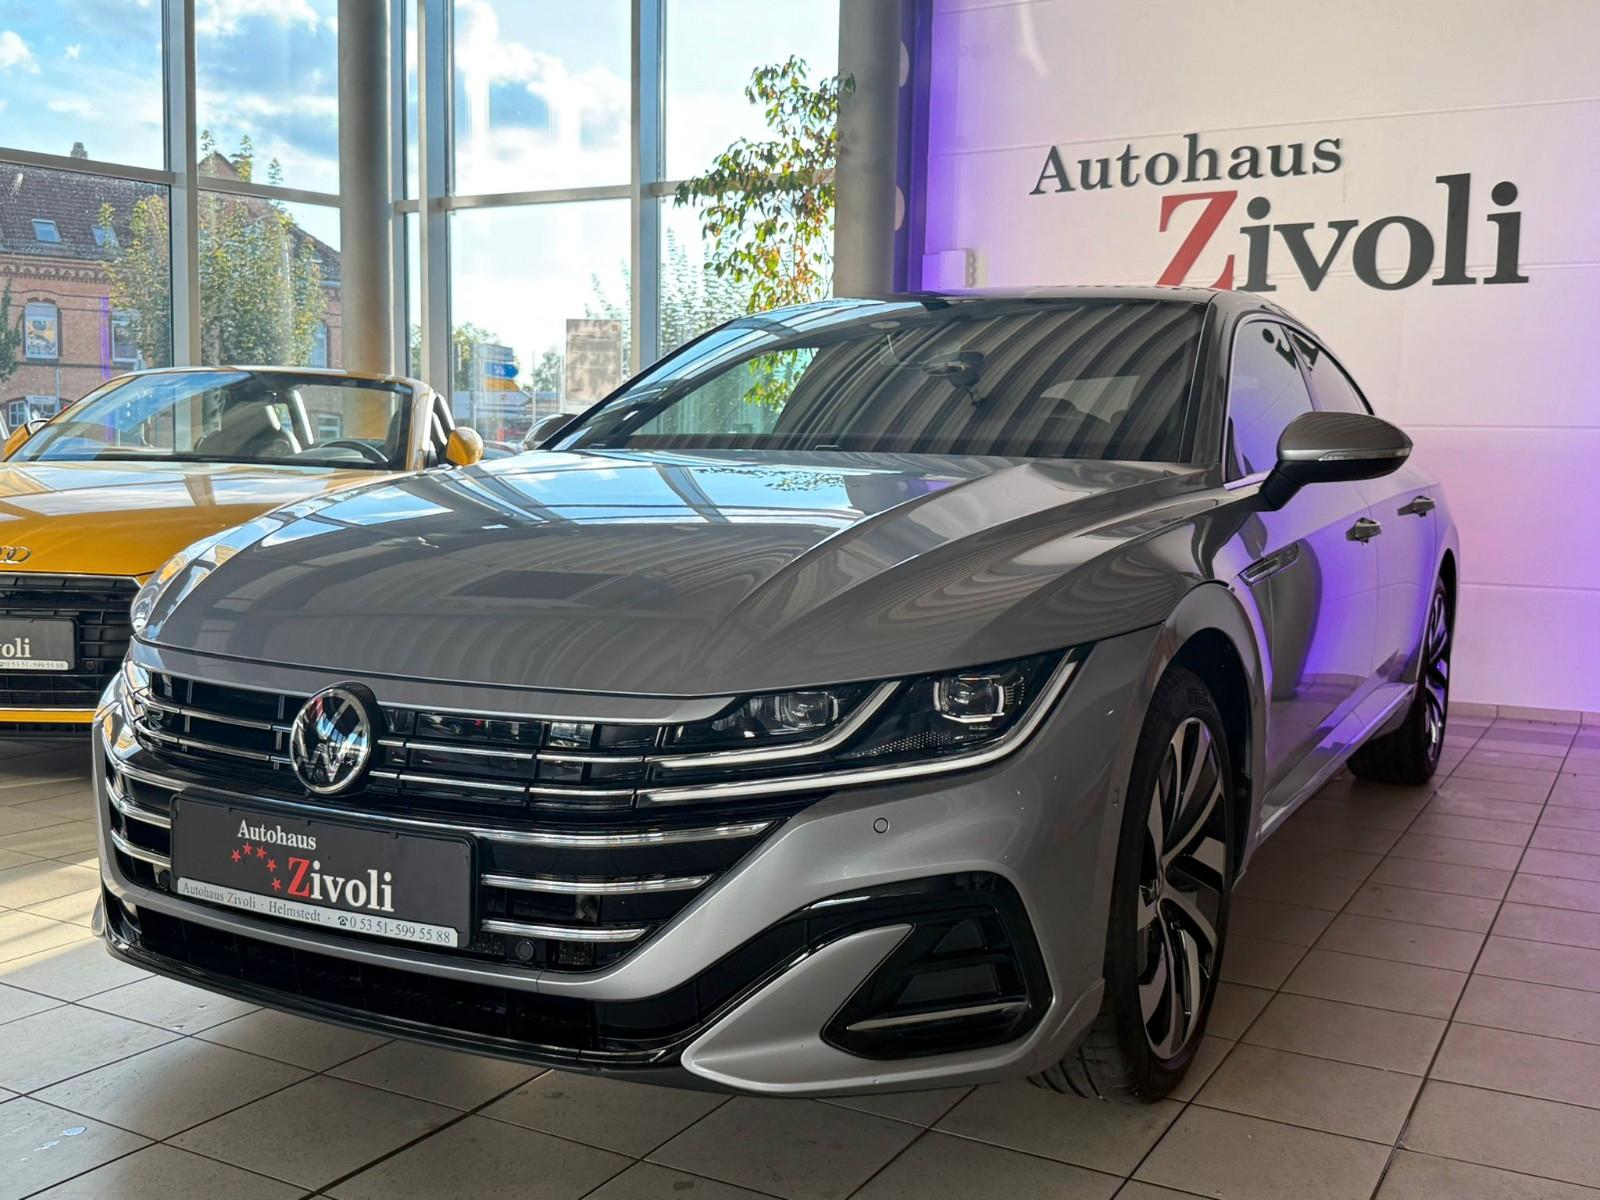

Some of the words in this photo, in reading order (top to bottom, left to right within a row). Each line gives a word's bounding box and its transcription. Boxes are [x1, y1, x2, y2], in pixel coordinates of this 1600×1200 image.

[1029, 132, 1342, 196] Autohaus
[1156, 172, 1530, 292] Zivoli
[0, 637, 32, 658] oli
[237, 819, 317, 851] Autohaus
[182, 881, 225, 902] Autohaus
[226, 891, 257, 910] Zivoli
[268, 900, 322, 922] Helmstedt
[287, 856, 395, 913] Zivoli
